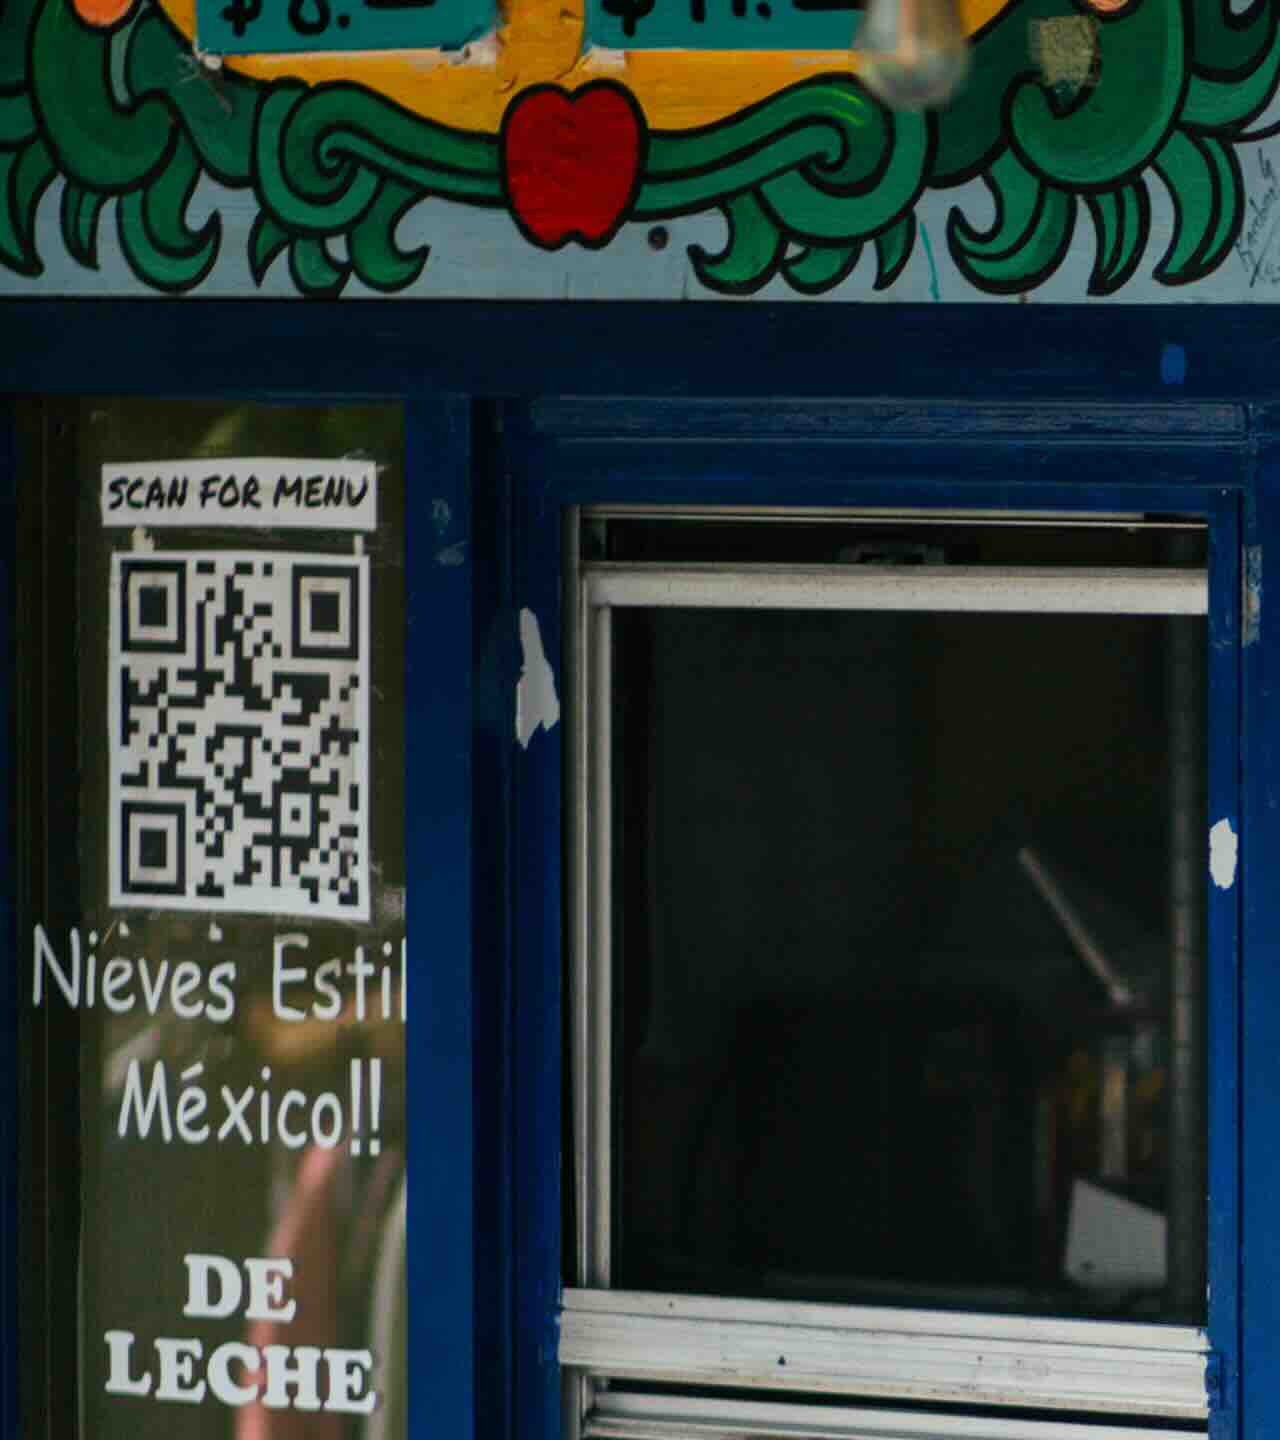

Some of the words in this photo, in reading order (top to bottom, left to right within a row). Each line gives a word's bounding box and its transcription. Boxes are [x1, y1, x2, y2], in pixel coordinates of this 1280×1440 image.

[108, 475, 189, 510] SCAN
[200, 474, 262, 510] FOR
[274, 475, 369, 510] MENU
[183, 1253, 297, 1323] DE
[103, 1329, 377, 1416] LECHE
